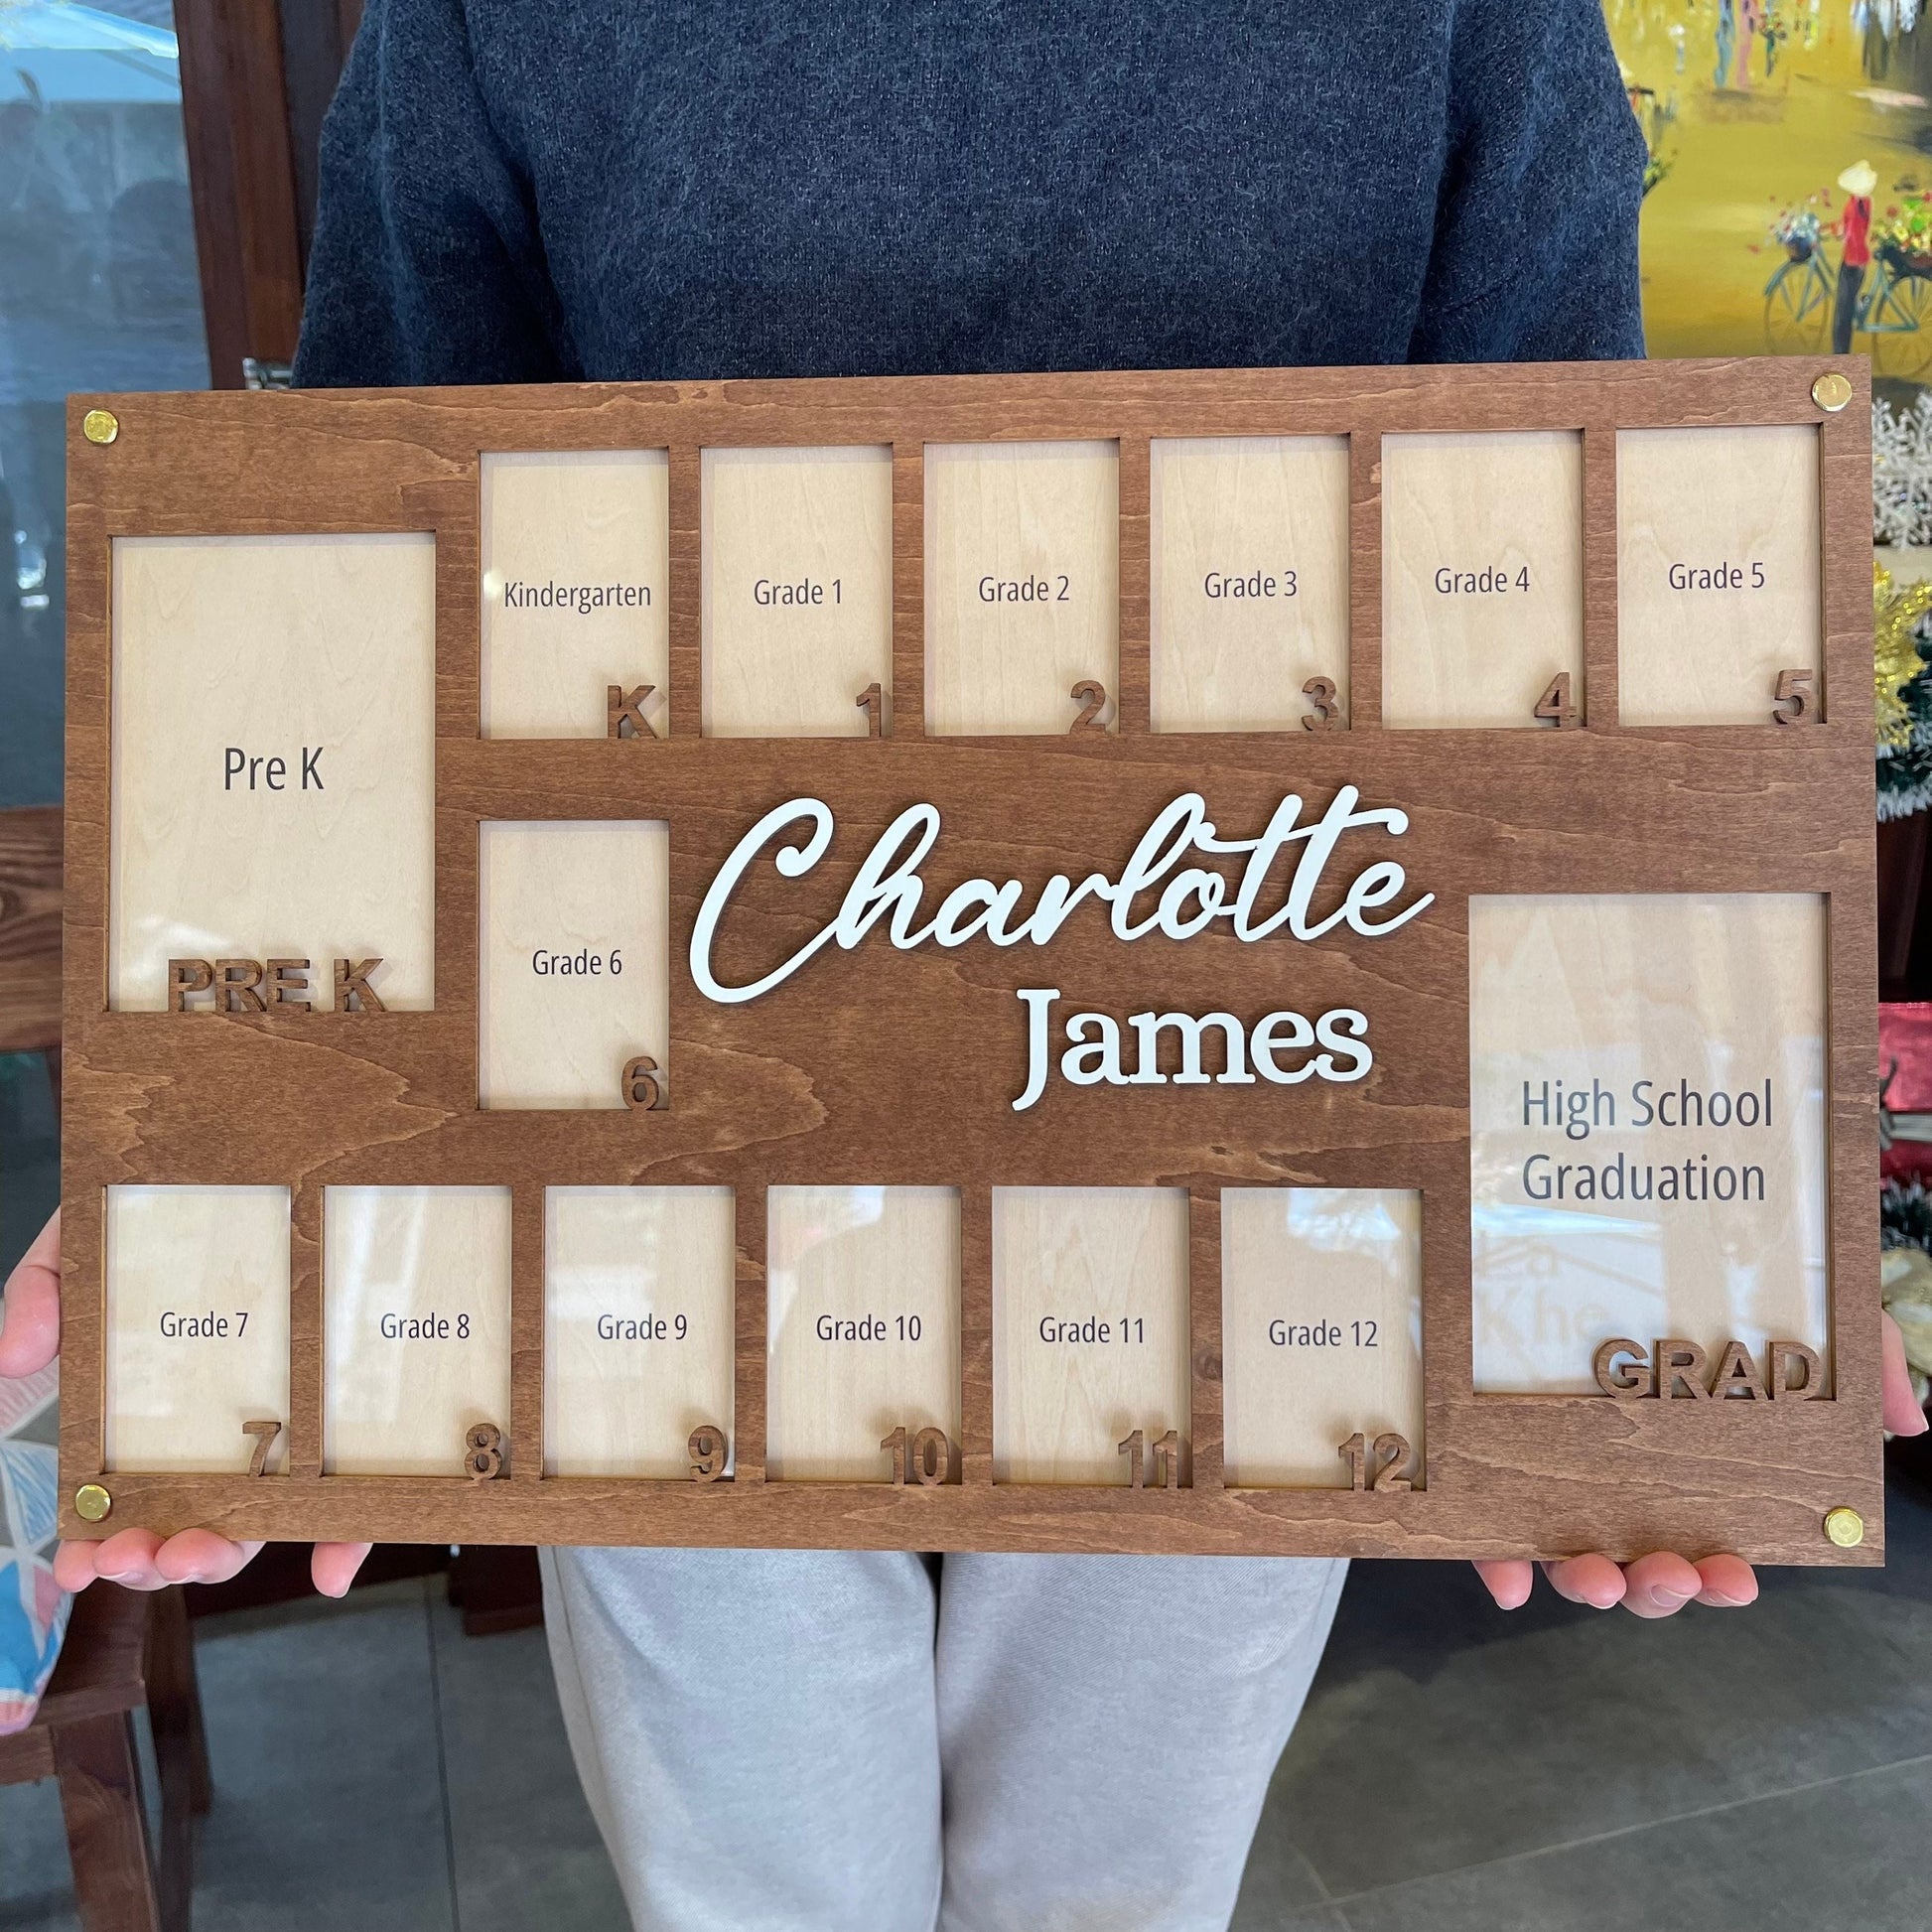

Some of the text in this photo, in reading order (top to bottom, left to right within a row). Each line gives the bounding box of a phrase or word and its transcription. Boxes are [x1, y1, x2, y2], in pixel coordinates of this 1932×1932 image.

[505, 580, 651, 615] Kindergarten
[754, 577, 842, 606] Grade 1
[978, 574, 1070, 603] Grade 2
[1204, 569, 1298, 598] Grade 3
[1435, 565, 1531, 594] Grade 4
[1669, 561, 1765, 590] Grade 5
[608, 685, 658, 740] K
[855, 682, 883, 738] 1
[1069, 679, 1107, 735] 2
[1302, 676, 1339, 732] 3
[1533, 671, 1577, 727] 4
[1772, 668, 1813, 725] 5
[224, 746, 325, 791] Pre K
[689, 784, 1436, 1004] Charlotte
[168, 957, 388, 1012] PRE K
[532, 947, 622, 976] Grade 6
[1012, 988, 1373, 1111] James
[621, 1055, 659, 1111] 6
[1523, 1077, 1772, 1141] High School
[1522, 1152, 1765, 1201] Graduation
[160, 1310, 249, 1338] Grade 7
[380, 1311, 471, 1339] Grade 8
[597, 1312, 688, 1340] Grade 9
[816, 1312, 922, 1341] Grade 10
[1038, 1314, 1145, 1344] Grade 11
[1269, 1318, 1379, 1347] Grade 12
[1592, 1338, 1823, 1401] GRAD
[241, 1421, 283, 1477] 7
[464, 1422, 502, 1480] 8
[687, 1424, 727, 1482] 9
[880, 1426, 950, 1486] 10
[1117, 1429, 1179, 1489] 11
[1337, 1432, 1414, 1492] 12
